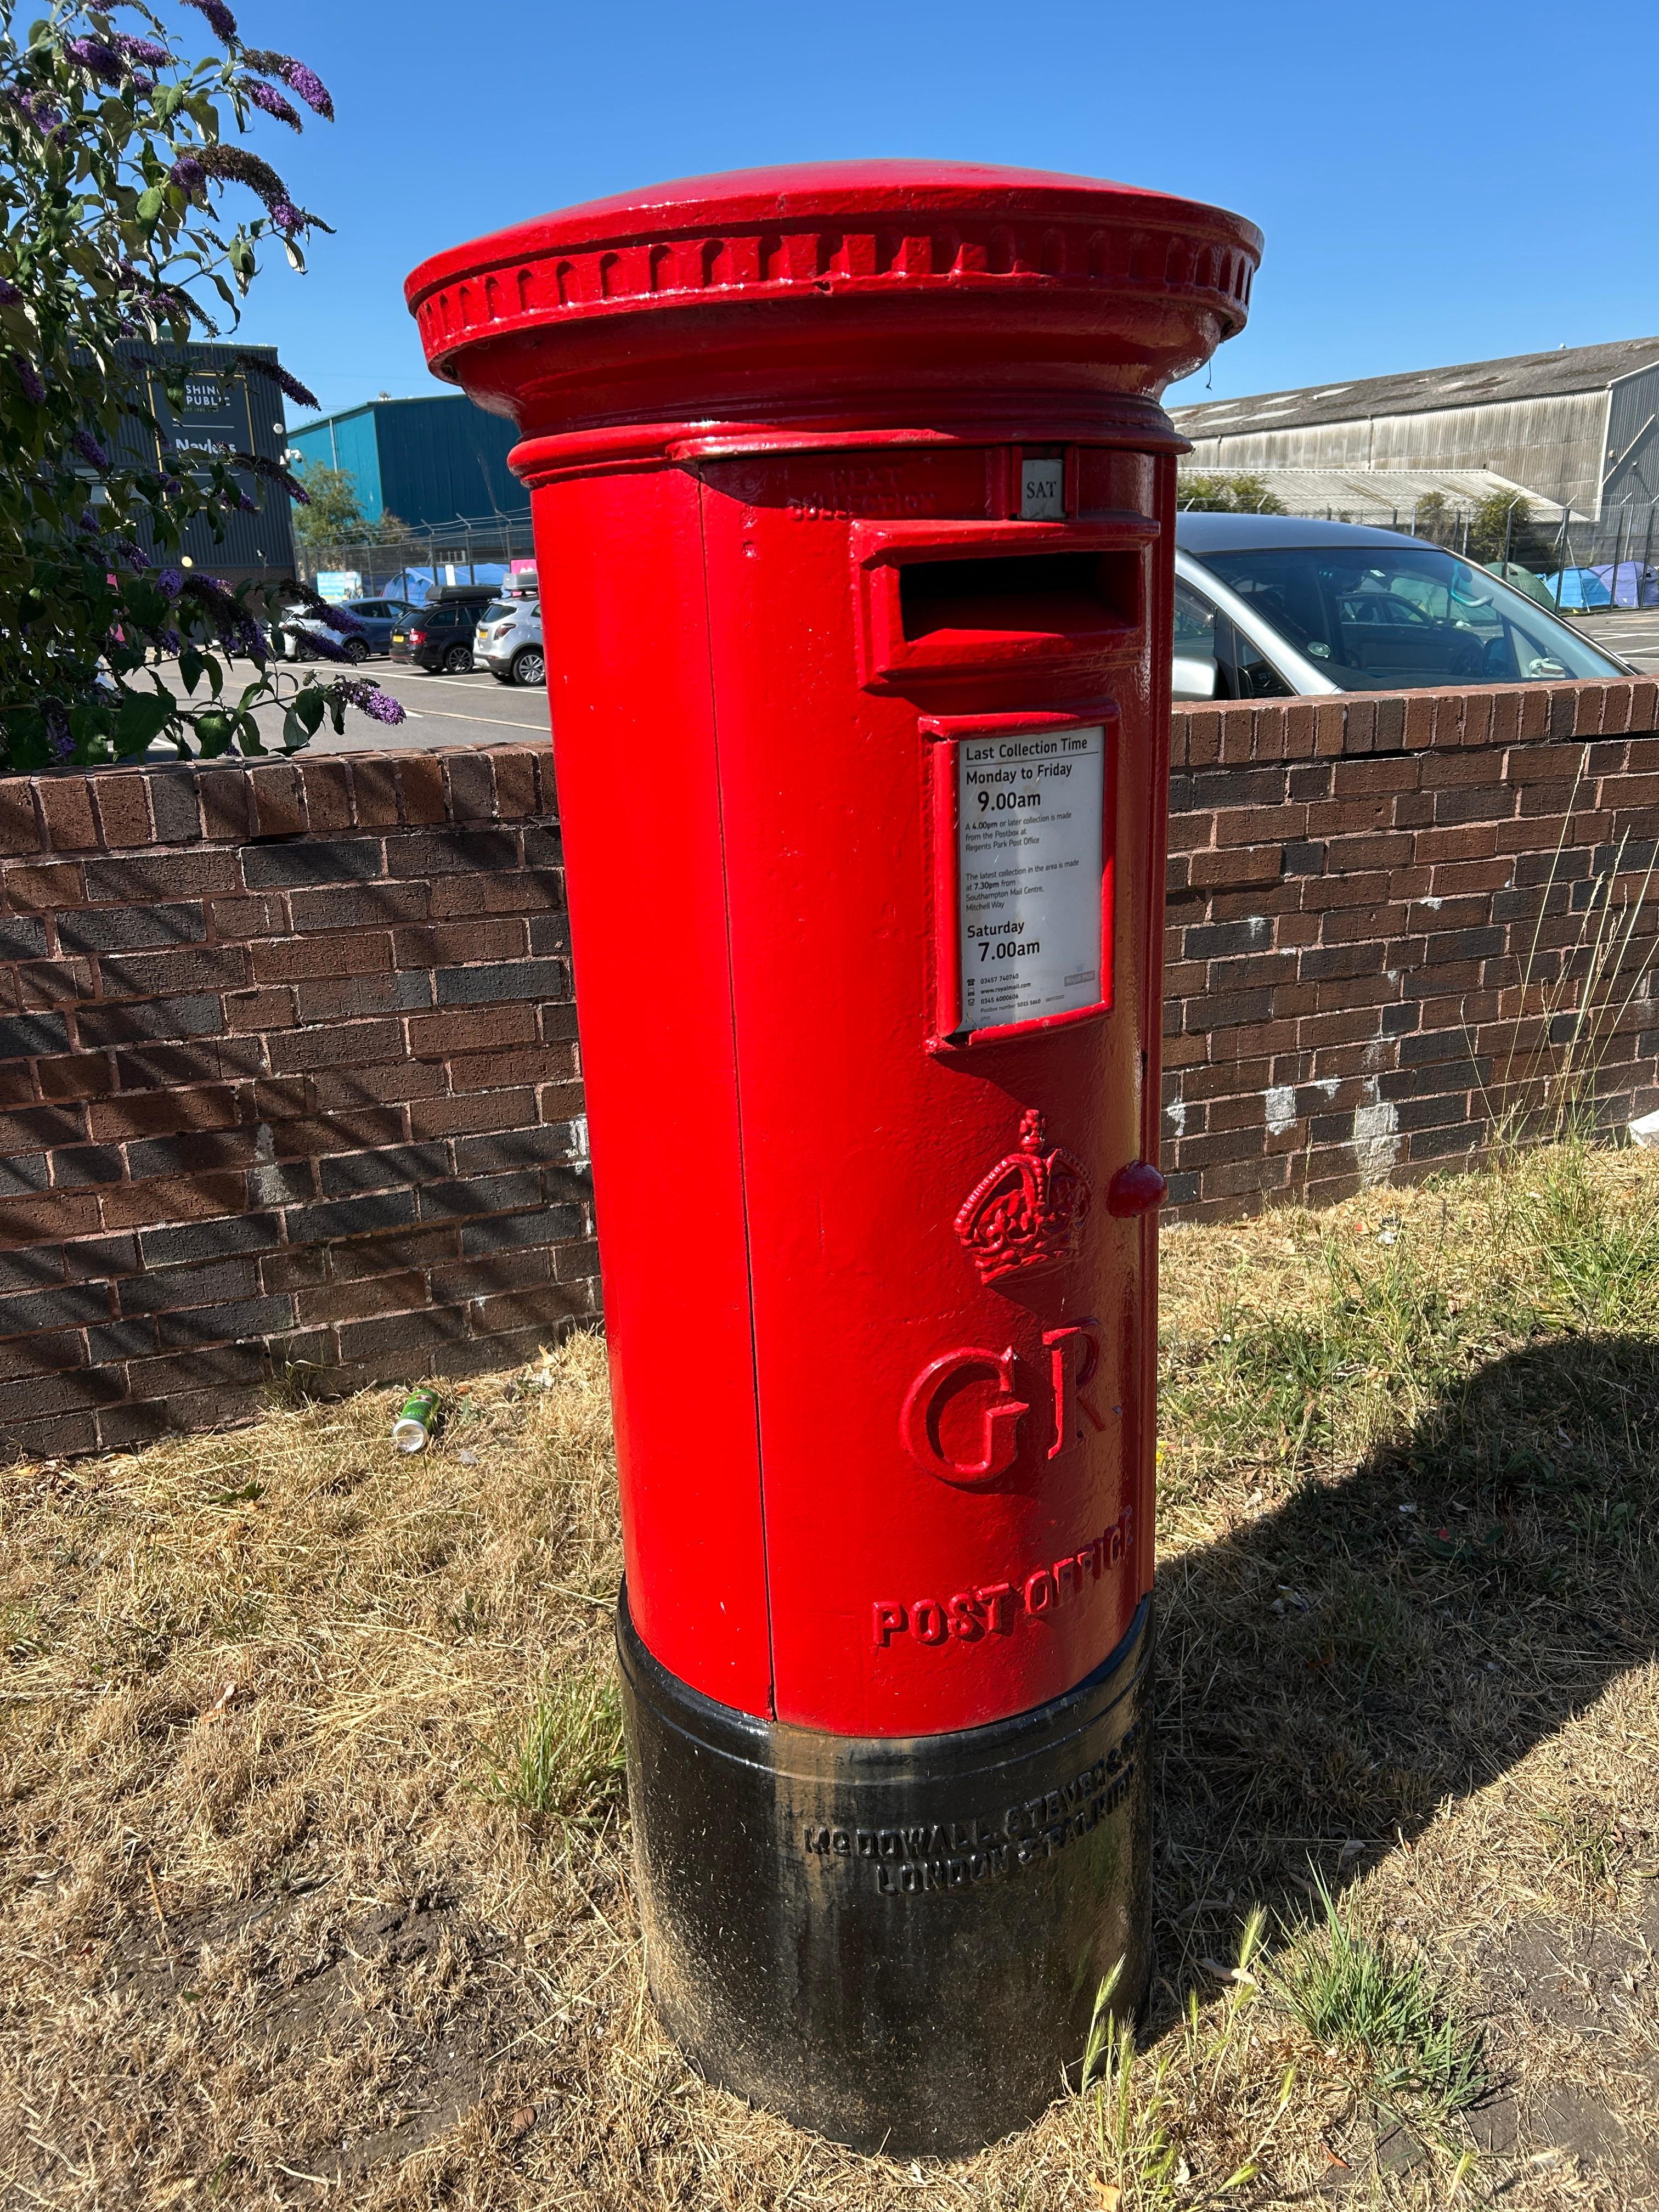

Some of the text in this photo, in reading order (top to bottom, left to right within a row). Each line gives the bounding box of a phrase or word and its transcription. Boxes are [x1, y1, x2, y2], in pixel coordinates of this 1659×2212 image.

[185, 396, 230, 407] PUBLIC
[1026, 481, 1057, 500] SAT
[966, 737, 1087, 760] Last Collection Time
[966, 763, 1073, 785] Monday to Friday
[978, 791, 1041, 812] 9.00am
[972, 821, 998, 831] 4.00pm
[1008, 819, 1022, 827] later
[1023, 815, 1049, 825] collection
[1057, 811, 1072, 820] made
[966, 833, 981, 842] from
[983, 831, 993, 839] the
[995, 829, 1019, 838] Postbox
[966, 836, 1040, 853] Regents Park Post Office
[966, 872, 978, 881] The
[980, 870, 997, 879] latest
[998, 867, 1026, 878] collection
[1035, 864, 1045, 873] the
[1064, 859, 1080, 868] made
[974, 881, 1000, 891] 7.30pm
[1001, 879, 1016, 888] from
[966, 891, 1008, 902] Southampton
[1010, 887, 1023, 896] Mail
[966, 900, 1005, 912] Mitchell Way
[967, 921, 1025, 939] Saturday
[977, 940, 1041, 962] 7.00am
[980, 973, 1019, 984] 03457 740740
[980, 981, 1031, 995] www.royalmail.com
[980, 996, 995, 1005] 0345
[900, 1317, 1107, 1484] GR
[873, 1504, 1134, 1648] POST OFFICE
[876, 1844, 1009, 1897] LONDON
